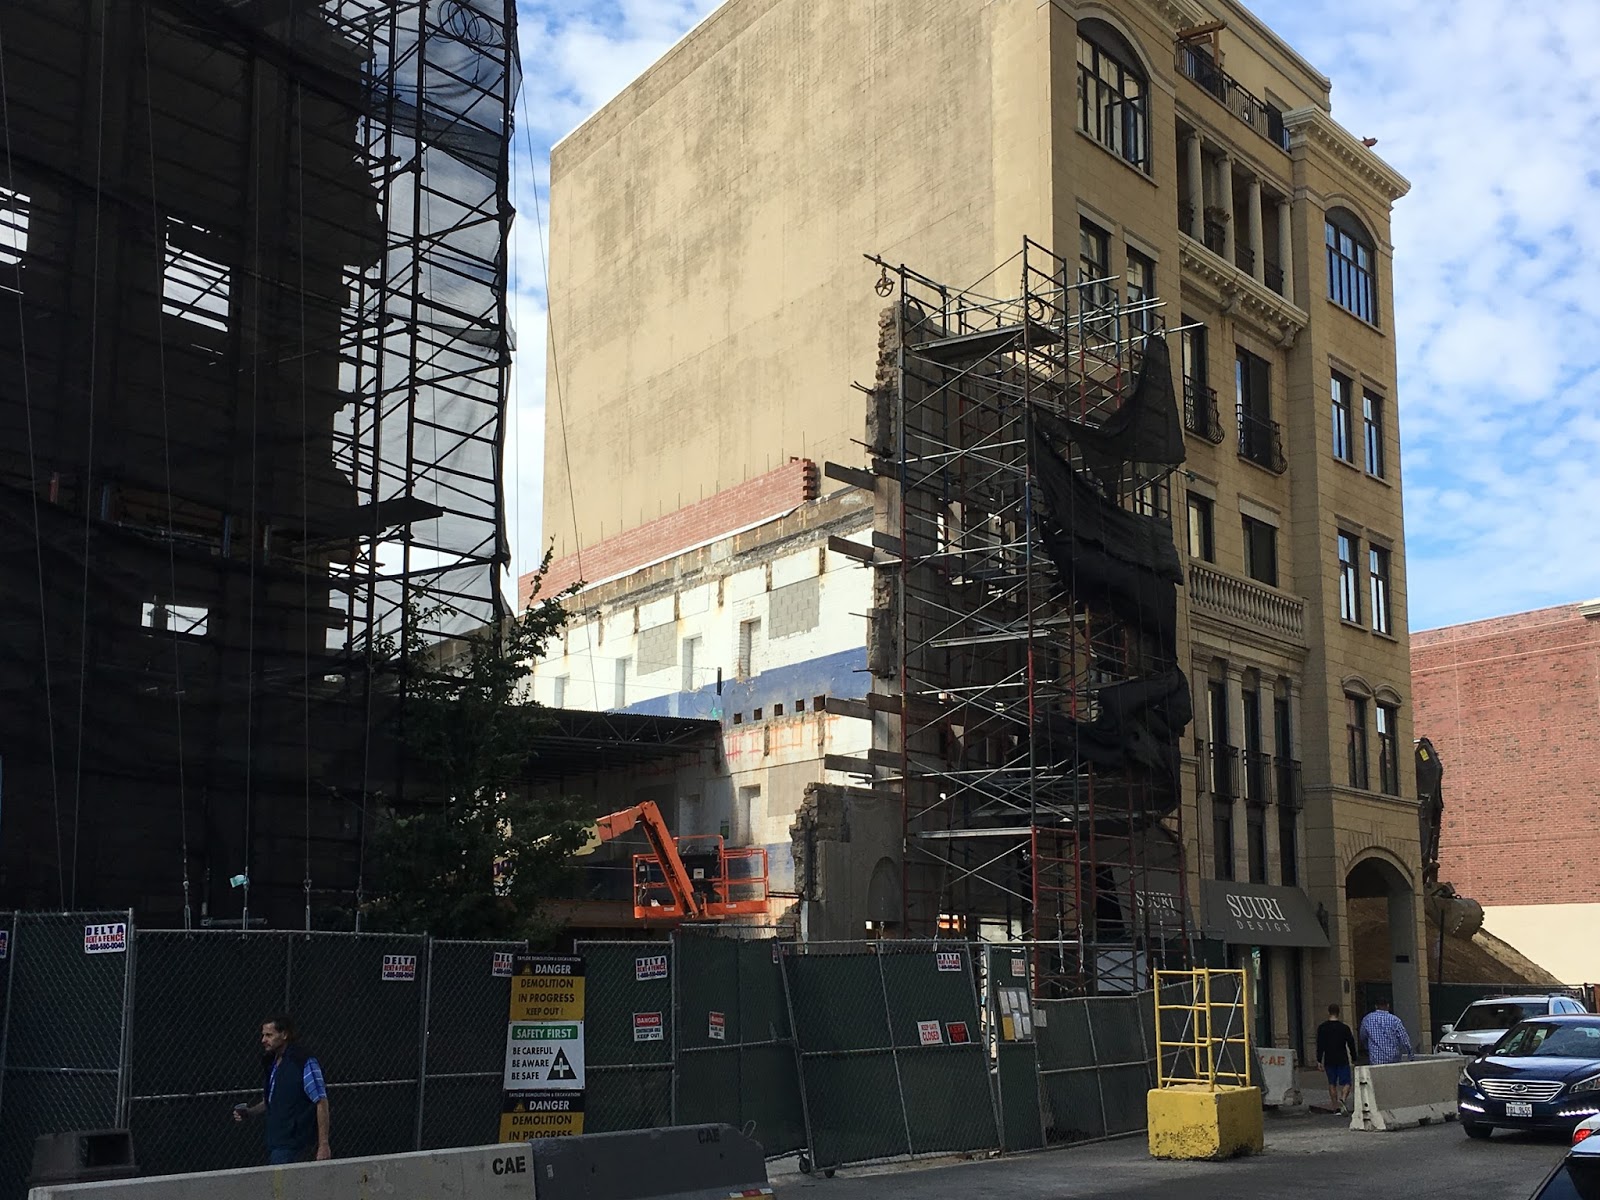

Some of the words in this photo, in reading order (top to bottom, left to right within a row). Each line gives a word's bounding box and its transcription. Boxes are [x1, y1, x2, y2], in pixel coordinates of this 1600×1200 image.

[1226, 893, 1286, 921] SUURI
[86, 925, 124, 936] DELTA
[1236, 920, 1291, 932] DESIGN
[86, 935, 97, 944] RENT
[103, 934, 124, 942] FENCE
[384, 957, 415, 965] DELTA
[495, 954, 511, 962] DEL
[637, 957, 666, 966] DELTA
[535, 964, 571, 974] DANGER
[520, 978, 574, 989] DEMOLITION
[518, 993, 527, 1003] IN
[529, 993, 575, 1003] PROGRESS
[526, 1007, 541, 1016] KEEP
[543, 1007, 559, 1016] OUT
[637, 1016, 659, 1024] DANGER
[517, 1028, 545, 1039] SAFETY
[547, 1028, 572, 1038] FIRST
[922, 1031, 940, 1041] CLOSED
[512, 1046, 521, 1055] BE
[522, 1046, 553, 1055] CAREFUL
[512, 1059, 520, 1068] BE
[521, 1059, 550, 1068] AWARE
[511, 1071, 520, 1080] BE
[521, 1071, 540, 1080] SAFE
[529, 1100, 570, 1111] DANGER
[512, 1114, 572, 1126] DEMOLITION
[508, 1130, 519, 1141] IN
[522, 1130, 573, 1140] PROGRESS
[697, 1127, 721, 1144] CAE
[492, 1155, 526, 1175] CAE
